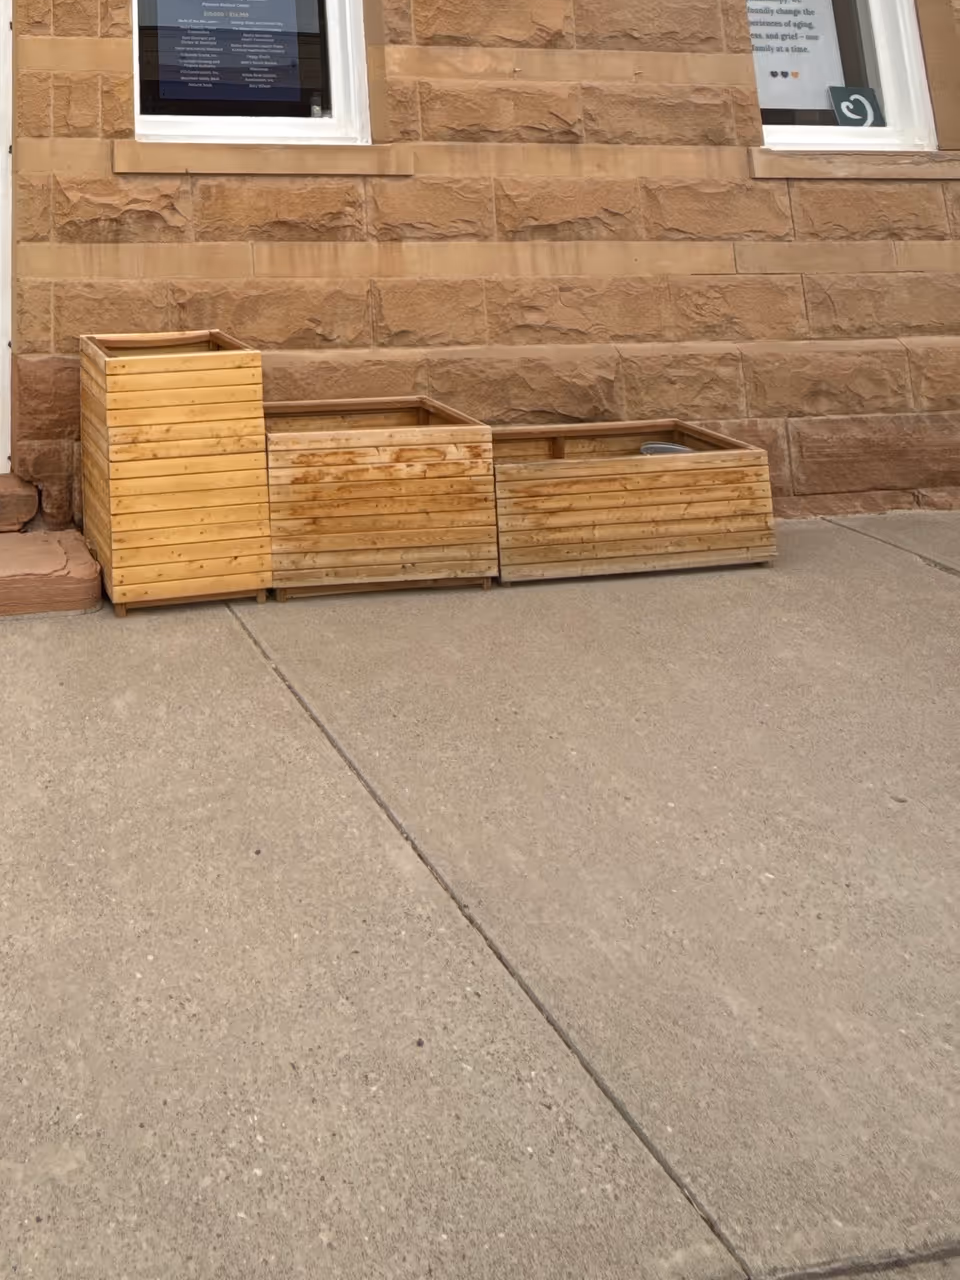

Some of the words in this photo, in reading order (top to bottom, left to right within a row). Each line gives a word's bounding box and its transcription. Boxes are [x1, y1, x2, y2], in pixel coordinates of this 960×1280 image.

[776, 7, 802, 17] change
[803, 8, 816, 16] the
[784, 19, 792, 28] of
[766, 32, 779, 40] and
[780, 32, 798, 42] grief
[776, 45, 784, 53] at
